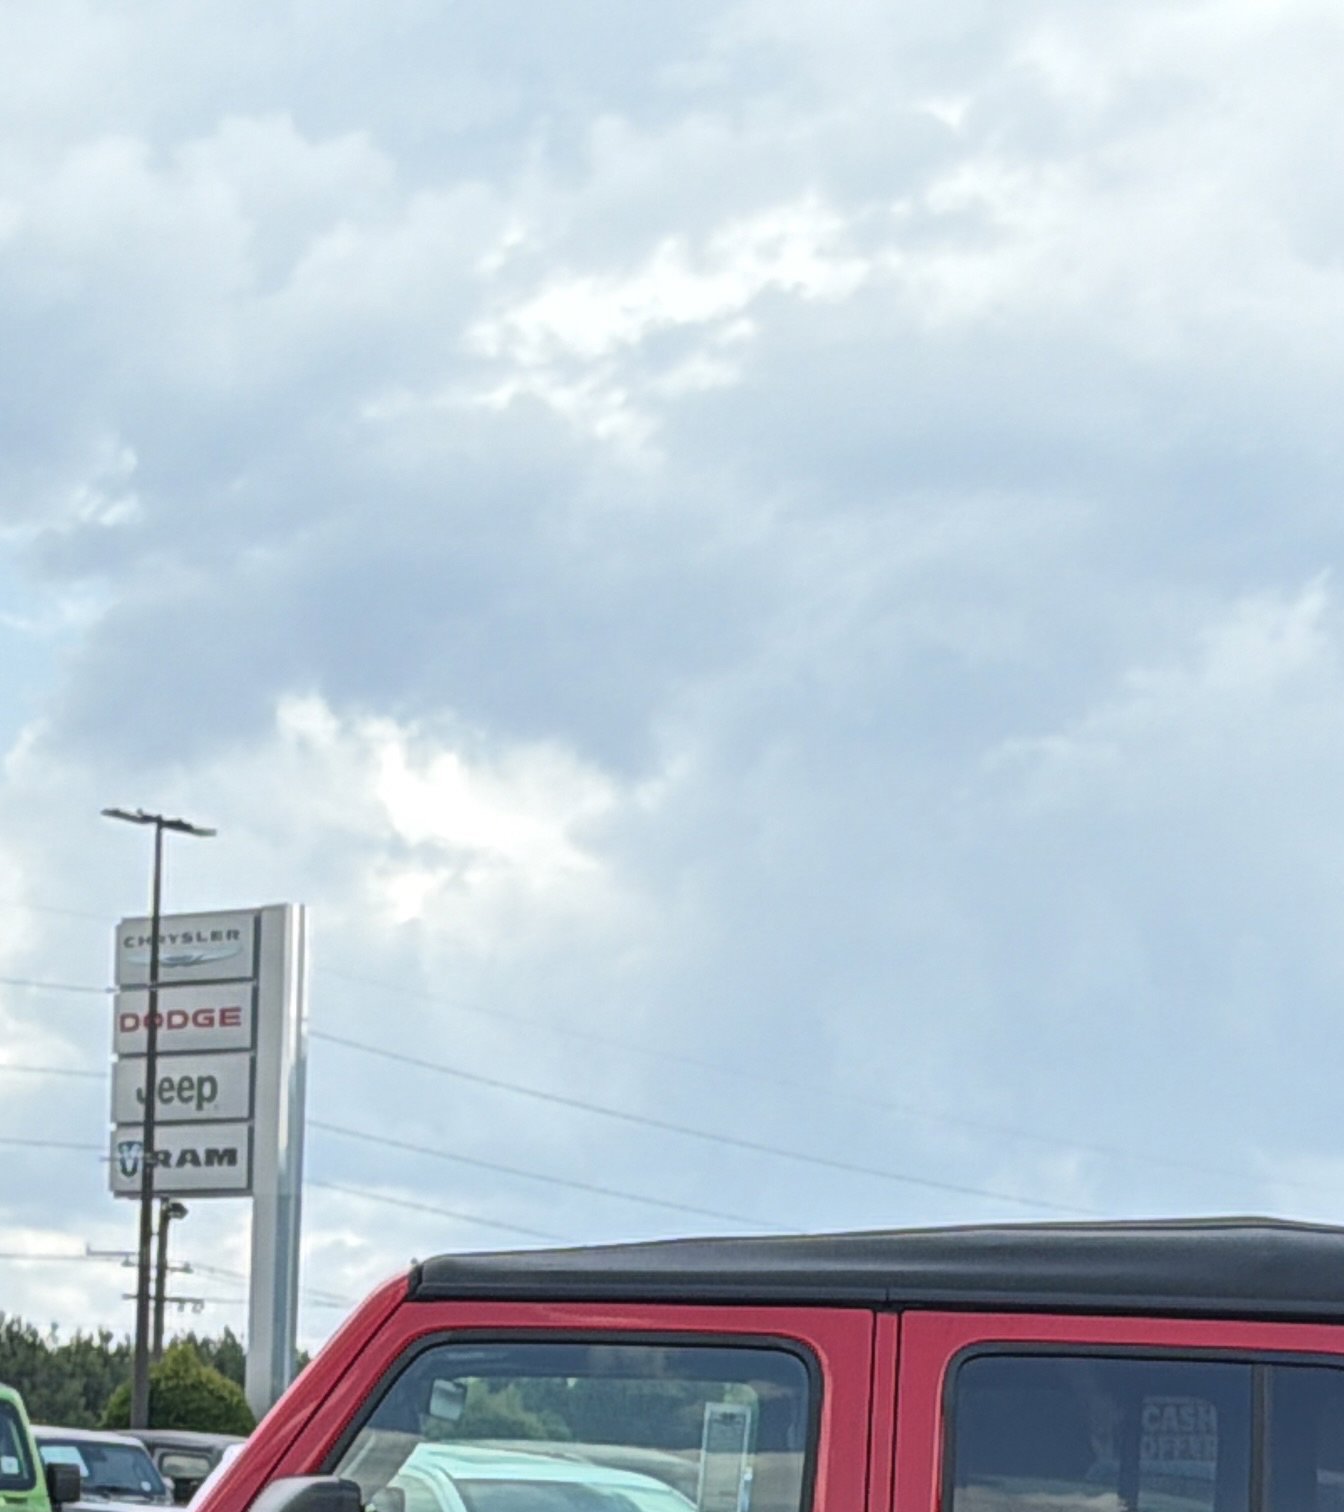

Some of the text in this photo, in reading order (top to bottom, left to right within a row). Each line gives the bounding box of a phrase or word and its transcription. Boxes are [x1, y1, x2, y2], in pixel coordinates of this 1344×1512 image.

[123, 929, 241, 948] CHRYSLER
[119, 1006, 242, 1033] DODGE
[152, 1147, 238, 1168] RAM
[1141, 1404, 1217, 1433] CASH
